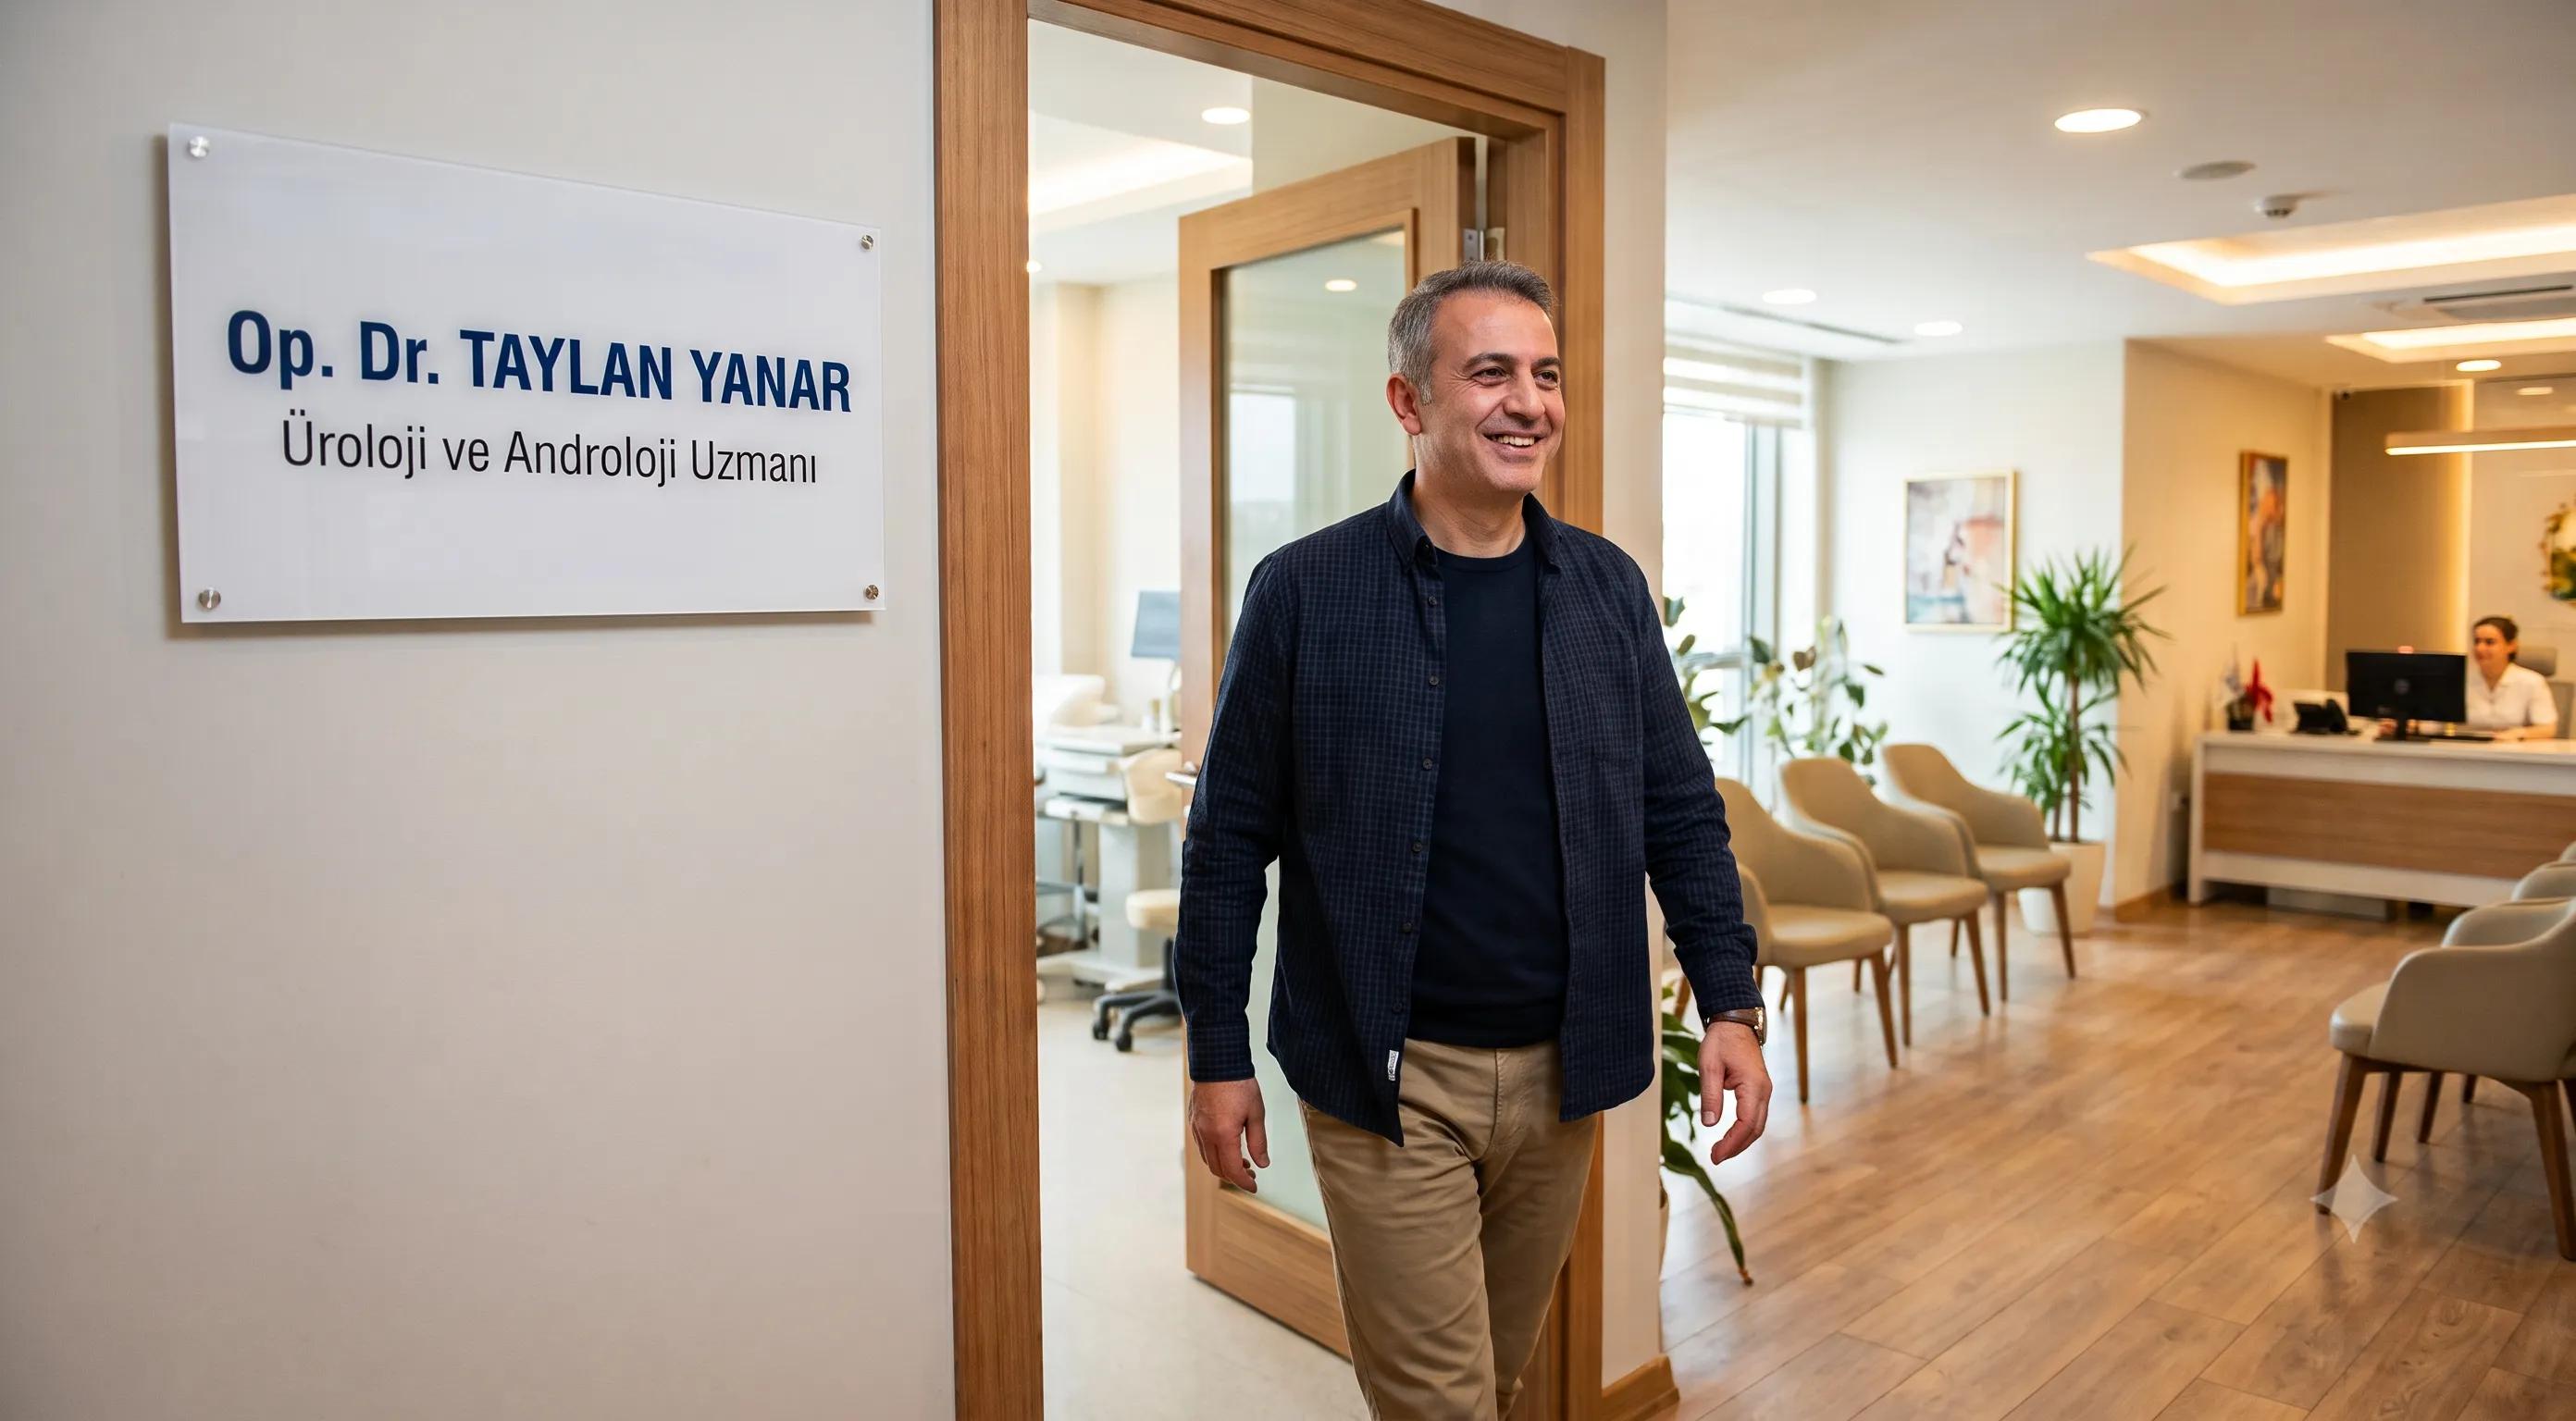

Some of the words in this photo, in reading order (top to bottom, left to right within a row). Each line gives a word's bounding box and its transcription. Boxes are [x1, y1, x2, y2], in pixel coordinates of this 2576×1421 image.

[227, 309, 334, 391] Op.
[360, 320, 440, 385] Dr.
[459, 328, 673, 401] TAYLAN
[688, 349, 851, 413] YANAR
[282, 408, 427, 480] Üroloji
[441, 438, 490, 473] ve
[503, 430, 676, 488] Androloji
[691, 439, 817, 484] Uzmanı
